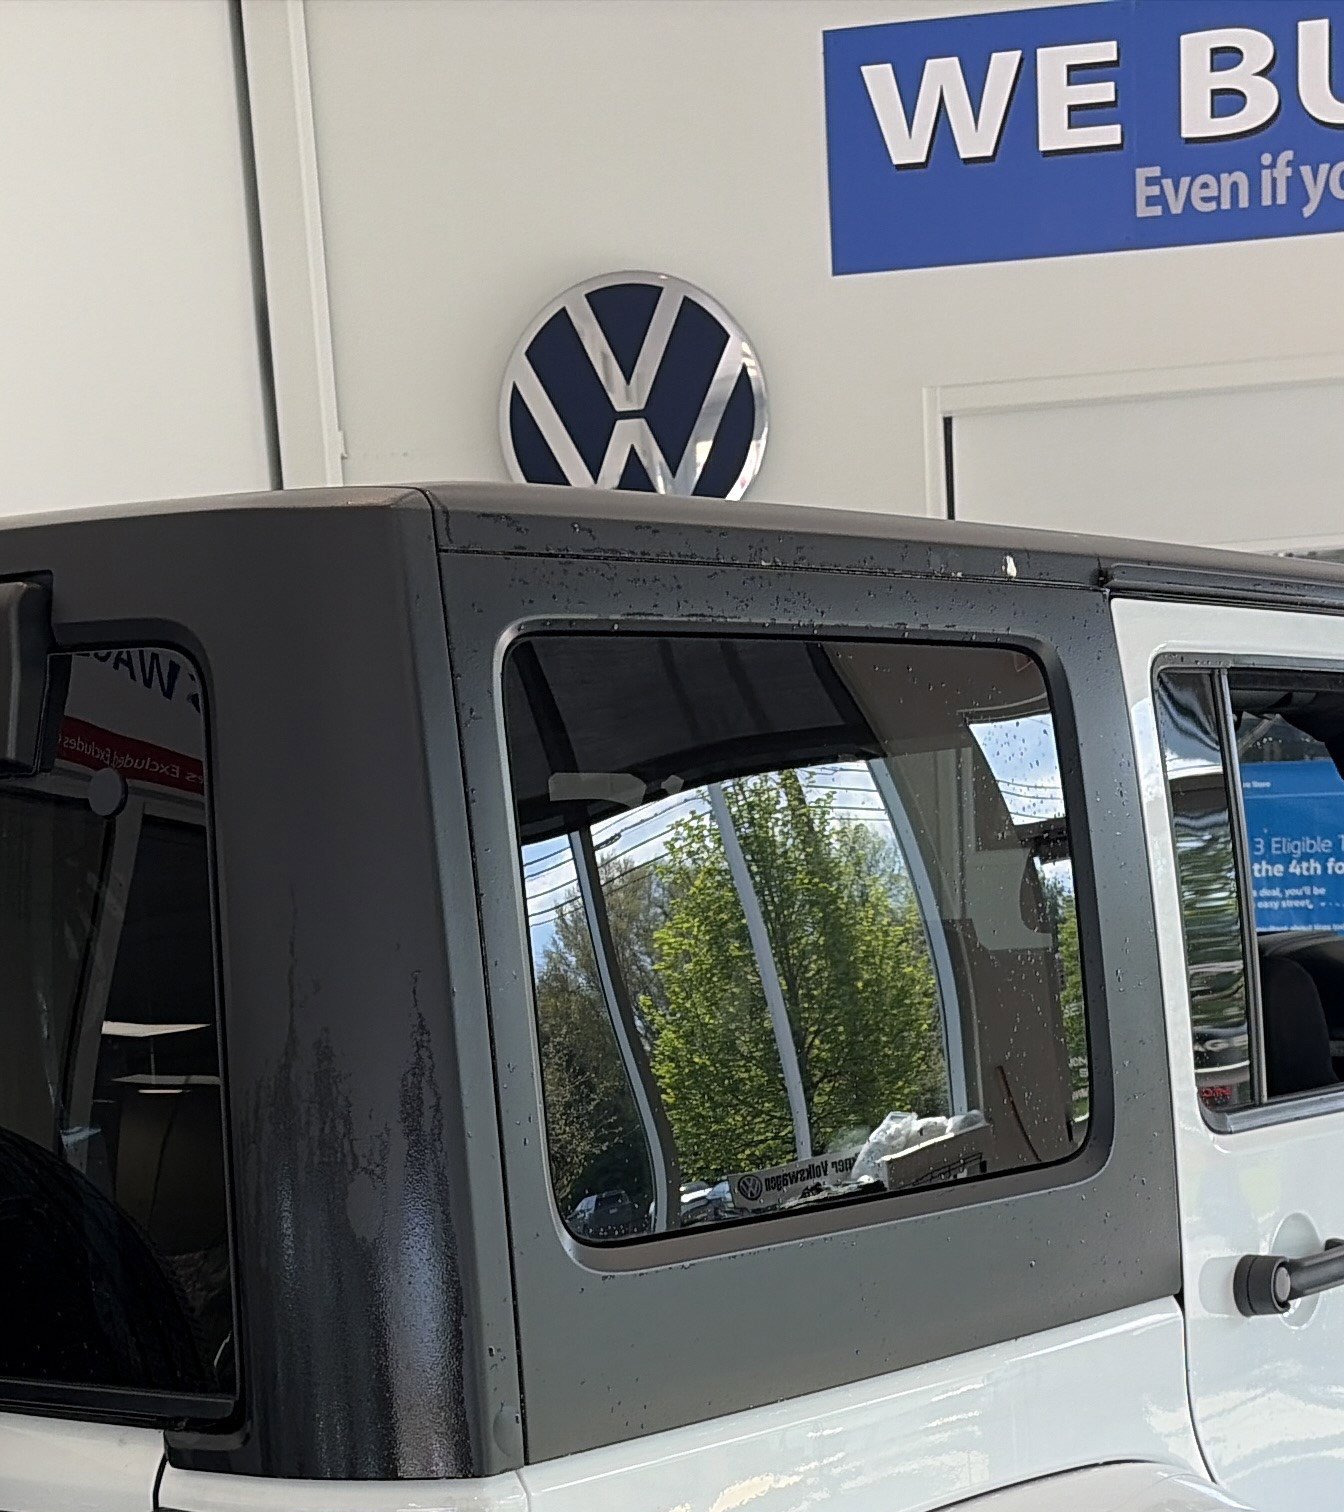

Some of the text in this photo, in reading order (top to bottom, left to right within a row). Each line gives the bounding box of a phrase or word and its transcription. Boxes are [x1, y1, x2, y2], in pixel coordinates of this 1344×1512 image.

[860, 40, 1123, 170] WE
[1135, 166, 1249, 218] Even
[1260, 151, 1293, 207] if
[1253, 838, 1264, 855] 3
[1270, 836, 1333, 858] Eligible
[1252, 861, 1284, 877] the
[1288, 858, 1321, 876] 4th
[1313, 886, 1326, 896] be
[1257, 901, 1280, 910] easy
